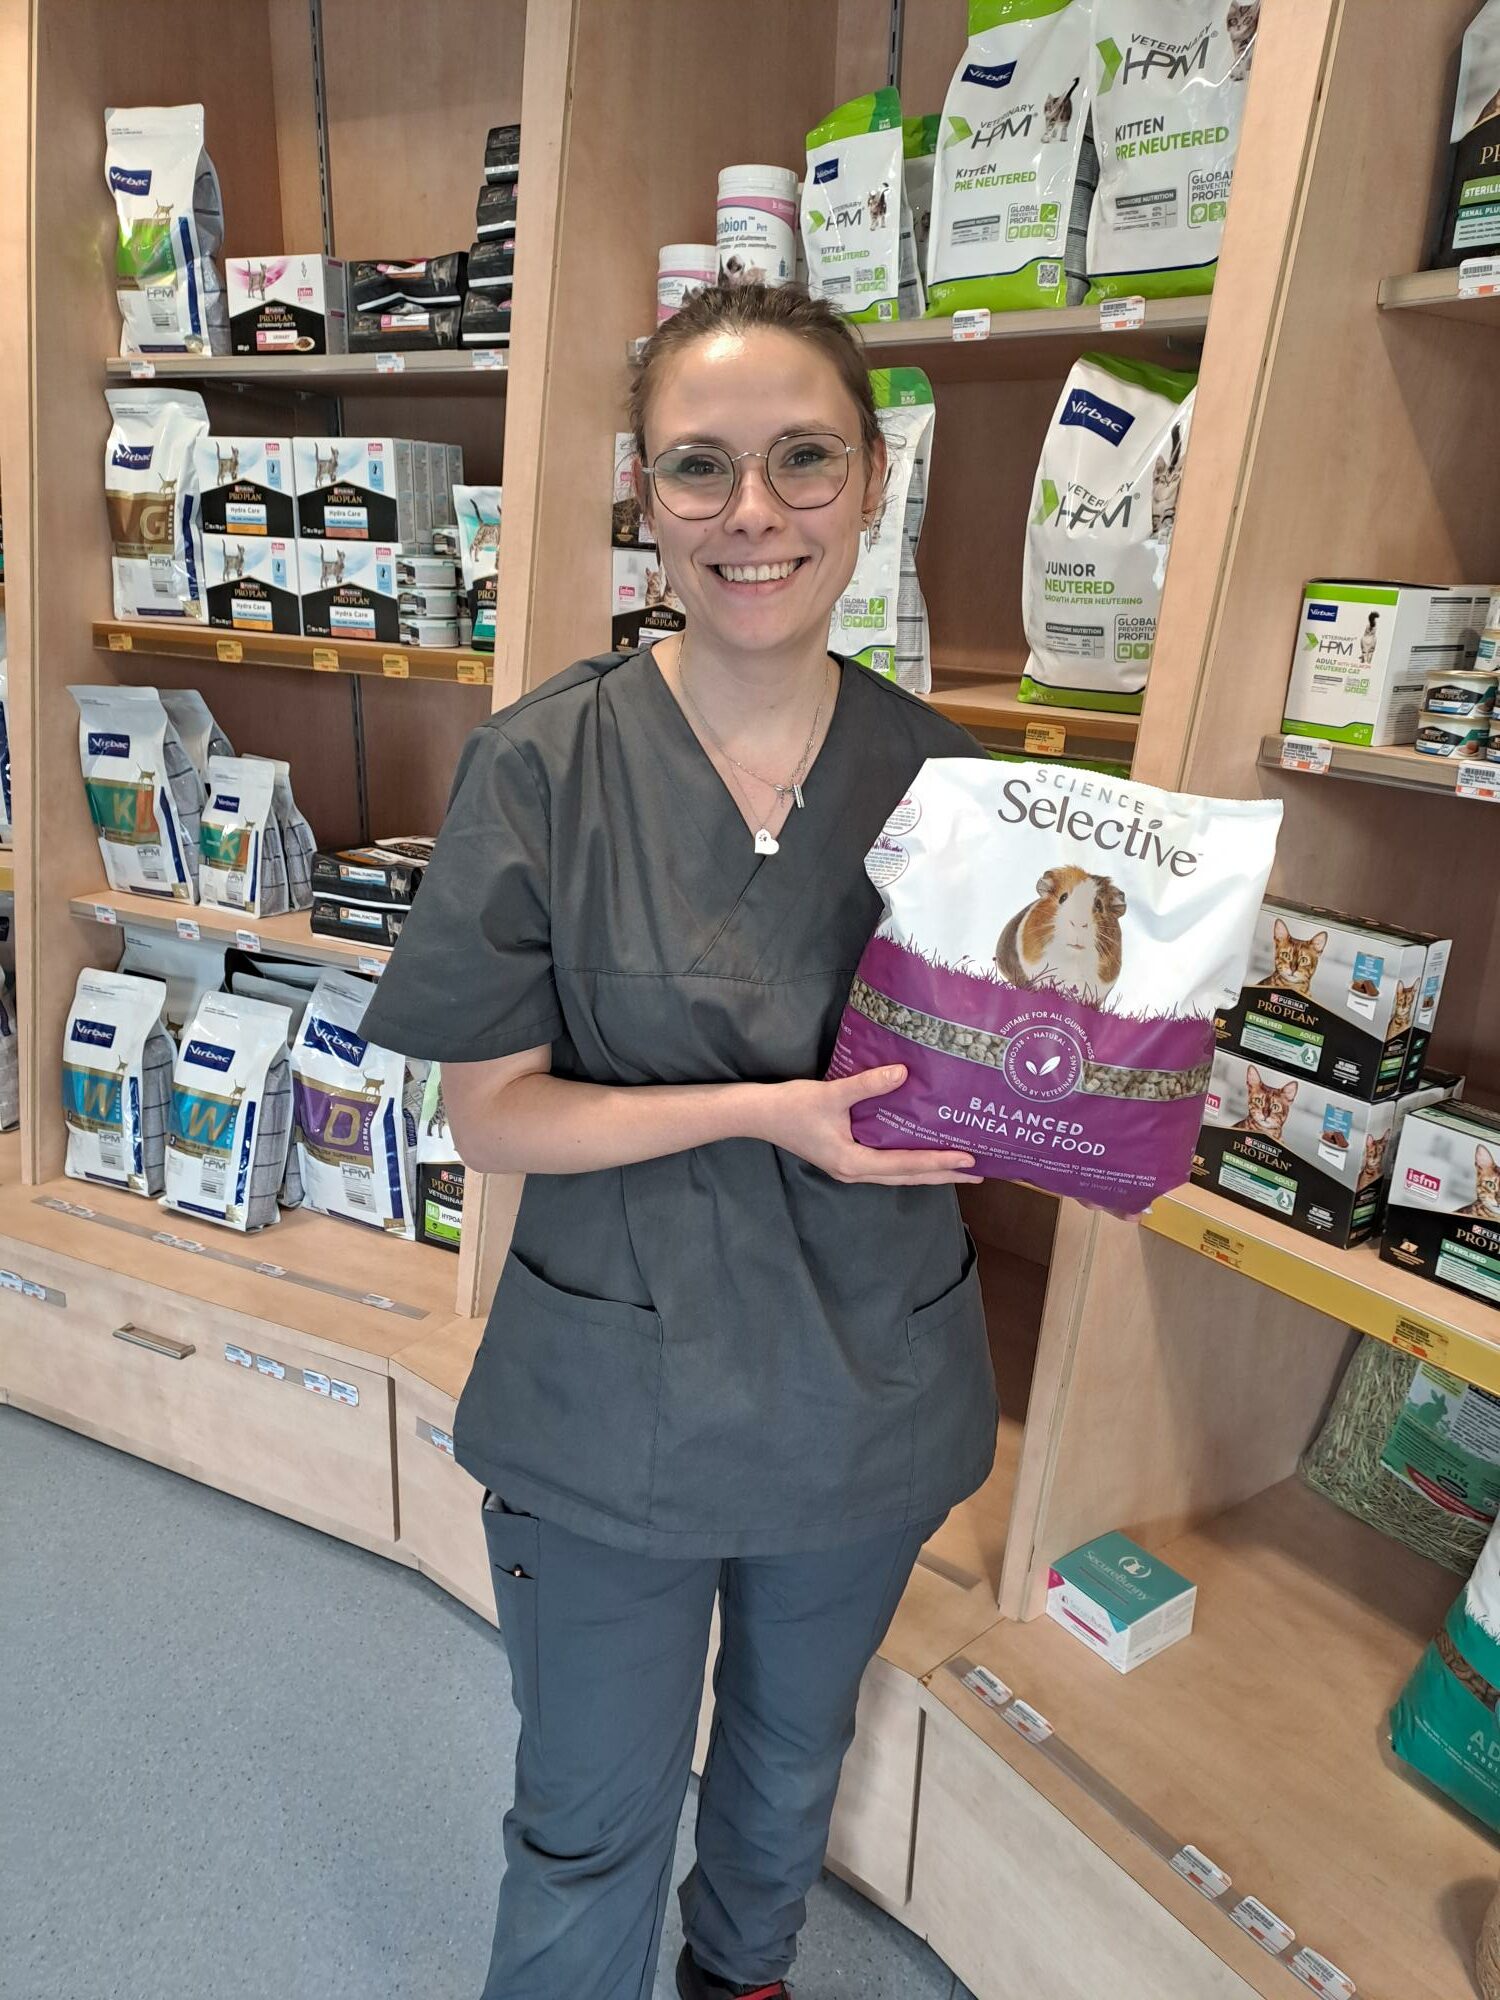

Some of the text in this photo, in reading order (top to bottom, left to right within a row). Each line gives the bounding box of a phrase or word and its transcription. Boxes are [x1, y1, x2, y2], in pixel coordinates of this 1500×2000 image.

[1123, 35, 1210, 85] HPM
[969, 68, 1012, 82] Virbac
[980, 103, 1035, 129] VETERINARY
[971, 113, 1033, 149] HPM
[1115, 116, 1164, 142] KITTEN
[1116, 126, 1230, 160] PRE NEUTERED
[110, 171, 150, 187] Virbac
[955, 162, 997, 180] KITTEN
[953, 171, 1037, 193] PRE NEUTERED
[1010, 204, 1039, 213] GLOBAL
[1462, 209, 1484, 218] RENAL
[1010, 216, 1038, 225] PROFILE
[146, 286, 174, 299] HPM
[260, 314, 293, 322] PRO PLAN
[1071, 400, 1124, 433] Virbac
[344, 496, 362, 504] PLAN
[230, 506, 245, 514] Hydra
[329, 510, 345, 518] Hydra
[140, 506, 168, 540] G
[150, 559, 172, 568] HPM
[1046, 561, 1096, 577] JUNIOR
[250, 590, 267, 598] PLAN
[1045, 578, 1115, 594] NEUTERED
[334, 596, 370, 605] PRO PLAN
[478, 590, 496, 600] PRO
[335, 610, 368, 618] Hydra Care
[1310, 608, 1336, 617] Virbac
[645, 617, 680, 628] PRO PLAN
[1319, 640, 1354, 656] HPM
[1316, 657, 1337, 665] ADULT
[1315, 665, 1347, 674] NEUTERED
[92, 737, 129, 749] Virbac
[1035, 768, 1146, 815] SCIENCE
[113, 792, 134, 827] K
[997, 779, 1198, 878] Selective
[1278, 996, 1304, 1009] PURINA
[1256, 1000, 1316, 1026] PRO PLAN
[1248, 1014, 1282, 1030] STERILISED
[76, 1022, 112, 1039] Virbac
[1000, 1012, 1030, 1035] SUITABLE
[1050, 1012, 1062, 1021] ALL
[1064, 1018, 1088, 1042] GUINEA
[1086, 1042, 1094, 1060] PIGS
[1300, 1031, 1321, 1043] ADULT
[314, 1027, 362, 1054] Virbac
[1034, 1032, 1066, 1046] NATURAL
[190, 1044, 230, 1063] Virbac
[1008, 1040, 1077, 1097] RECOMMENDED BY VETERINARIANS
[190, 1102, 232, 1141] W
[969, 1096, 1084, 1136] BALANCED
[324, 1104, 360, 1146] D
[364, 1110, 374, 1151] DERMATO
[938, 1105, 1106, 1156] GUINEA PIG FOOD
[100, 1135, 120, 1144] HPM
[878, 1107, 892, 1117] HIGH
[904, 1120, 916, 1130] FOR
[916, 1125, 938, 1136] DENTAL
[940, 1132, 970, 1146] WELLBEING
[1081, 1166, 1106, 1176] SUPPORT
[900, 1126, 914, 1136] WITH
[915, 1132, 939, 1144] VITAMIN
[1253, 1140, 1278, 1154] PURINA
[203, 1158, 226, 1170] HPM
[1224, 1154, 1258, 1172] STERILISED
[1233, 1141, 1288, 1171] PRO PLAN
[342, 1167, 370, 1180] HPM
[1274, 1175, 1295, 1188] ADULT
[1408, 1169, 1438, 1190] isfm
[431, 1178, 454, 1194] PRO
[1456, 1228, 1486, 1248] PRO
[1444, 1242, 1488, 1264] STERILISED
